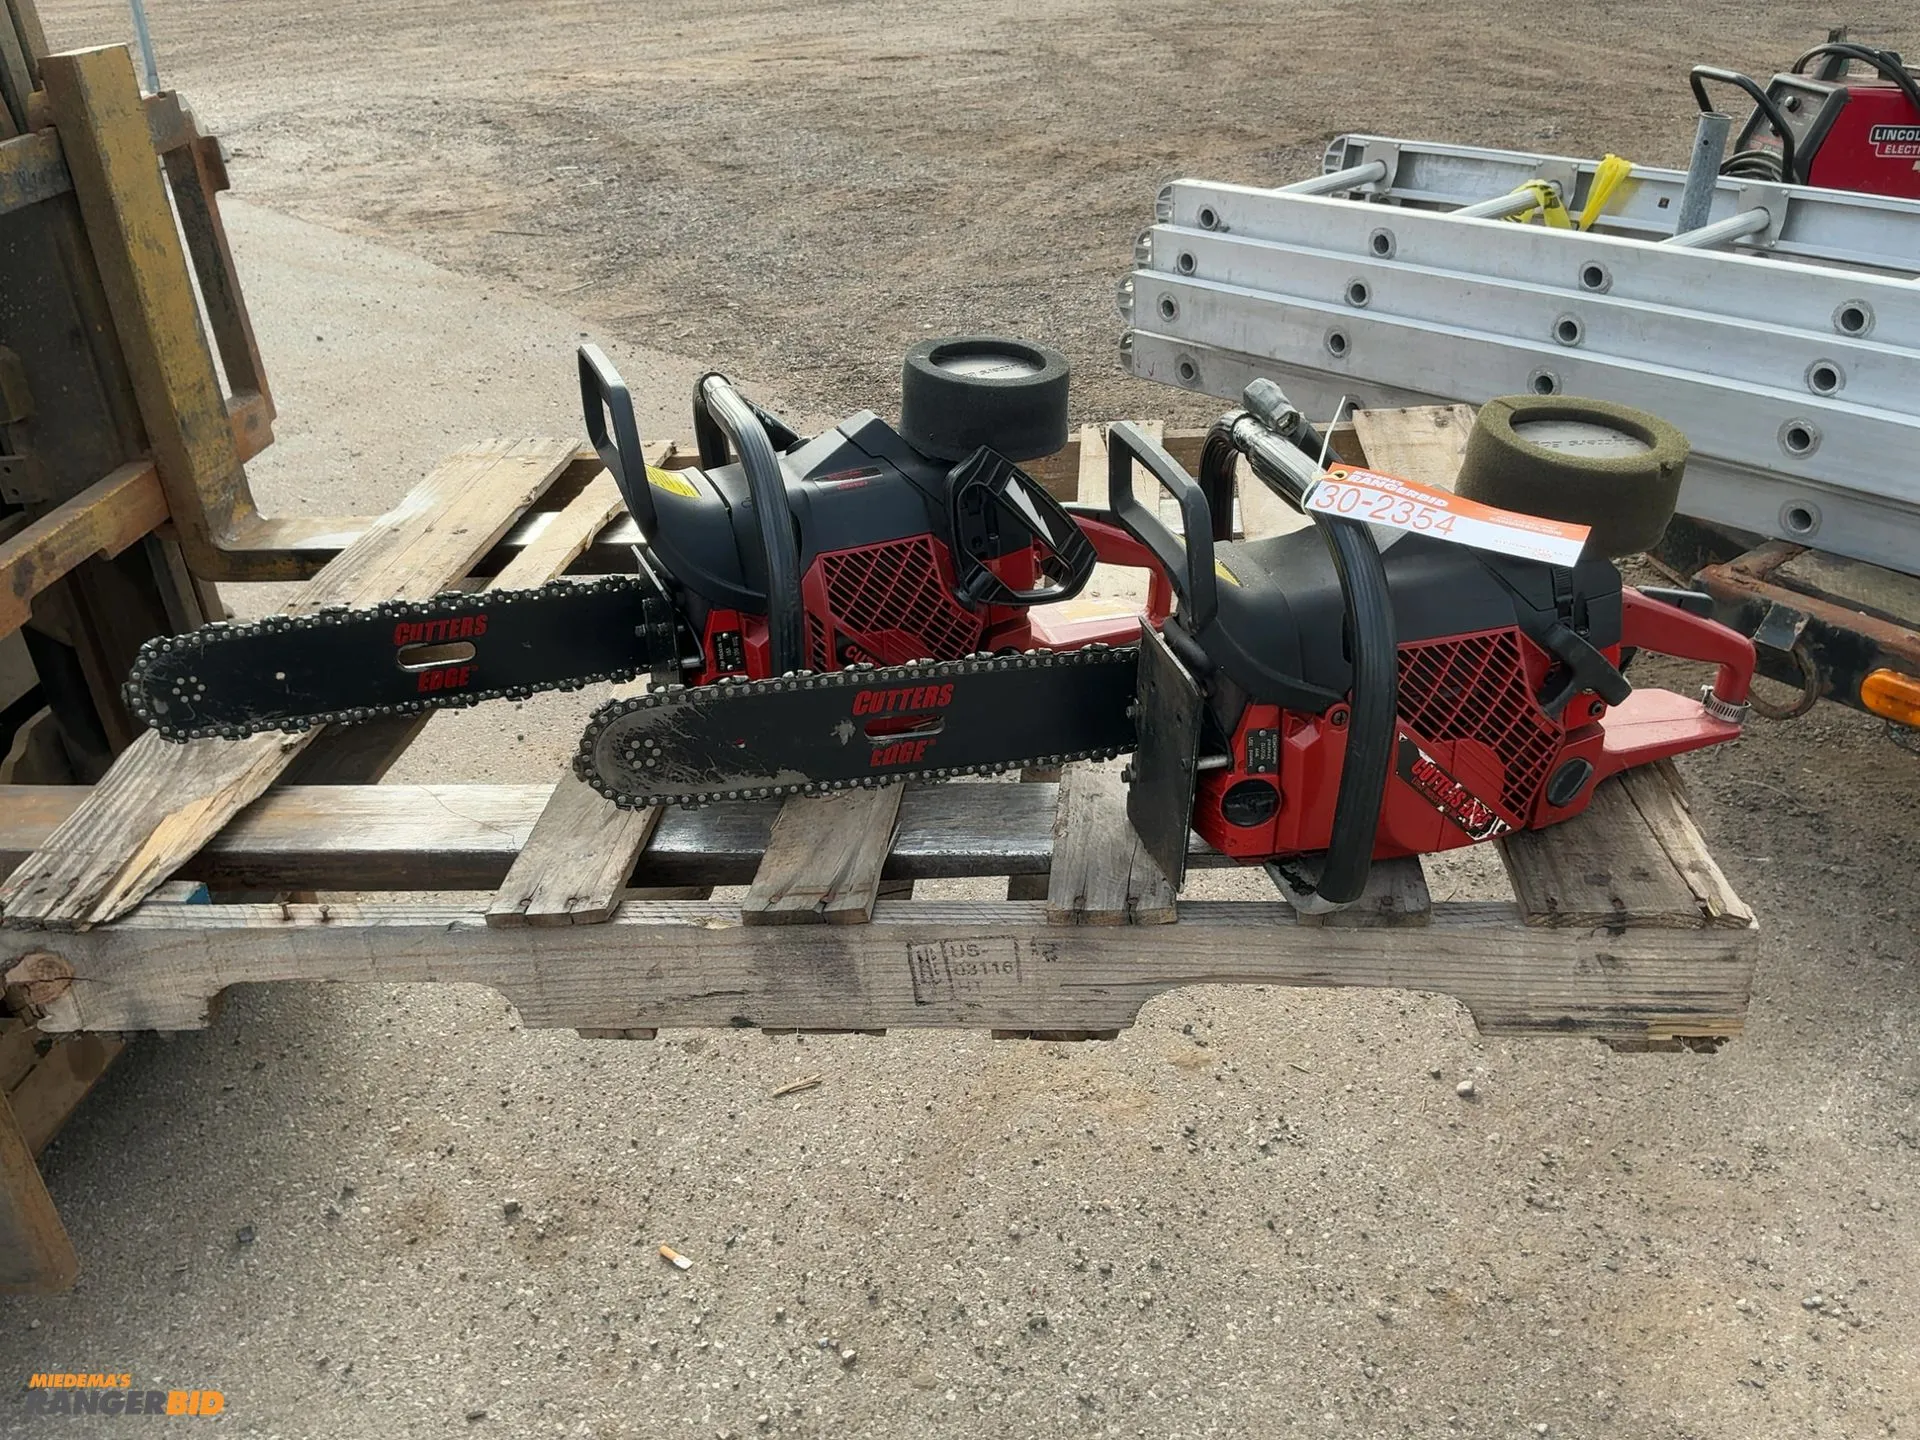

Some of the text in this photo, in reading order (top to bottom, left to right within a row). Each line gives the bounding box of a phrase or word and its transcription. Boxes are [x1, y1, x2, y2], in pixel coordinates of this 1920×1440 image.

[1314, 484, 1457, 536] 30-2354
[393, 614, 489, 646] CUTTERS
[852, 683, 954, 716] CUTTERS
[870, 740, 928, 767] EDGE
